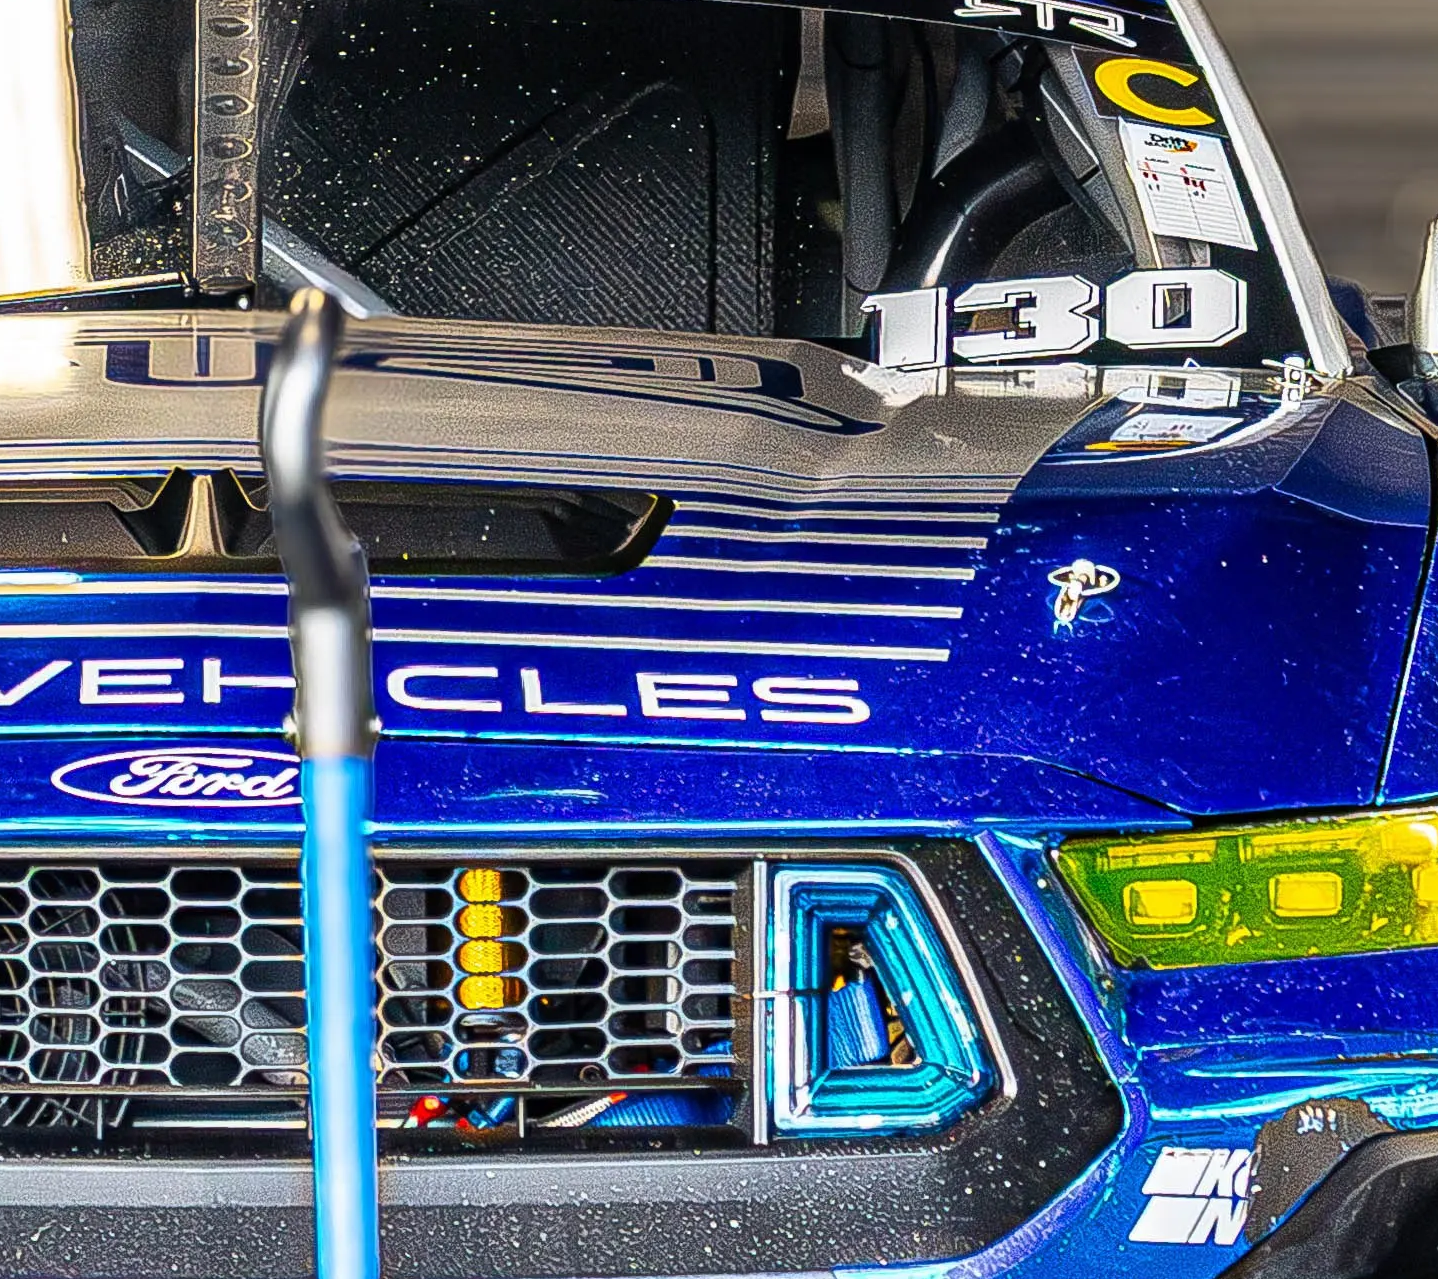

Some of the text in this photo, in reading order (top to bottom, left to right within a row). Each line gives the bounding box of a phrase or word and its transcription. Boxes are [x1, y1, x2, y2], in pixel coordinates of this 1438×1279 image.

[1094, 57, 1216, 126] C
[861, 268, 1248, 372] 130
[109, 755, 299, 798] Ford
